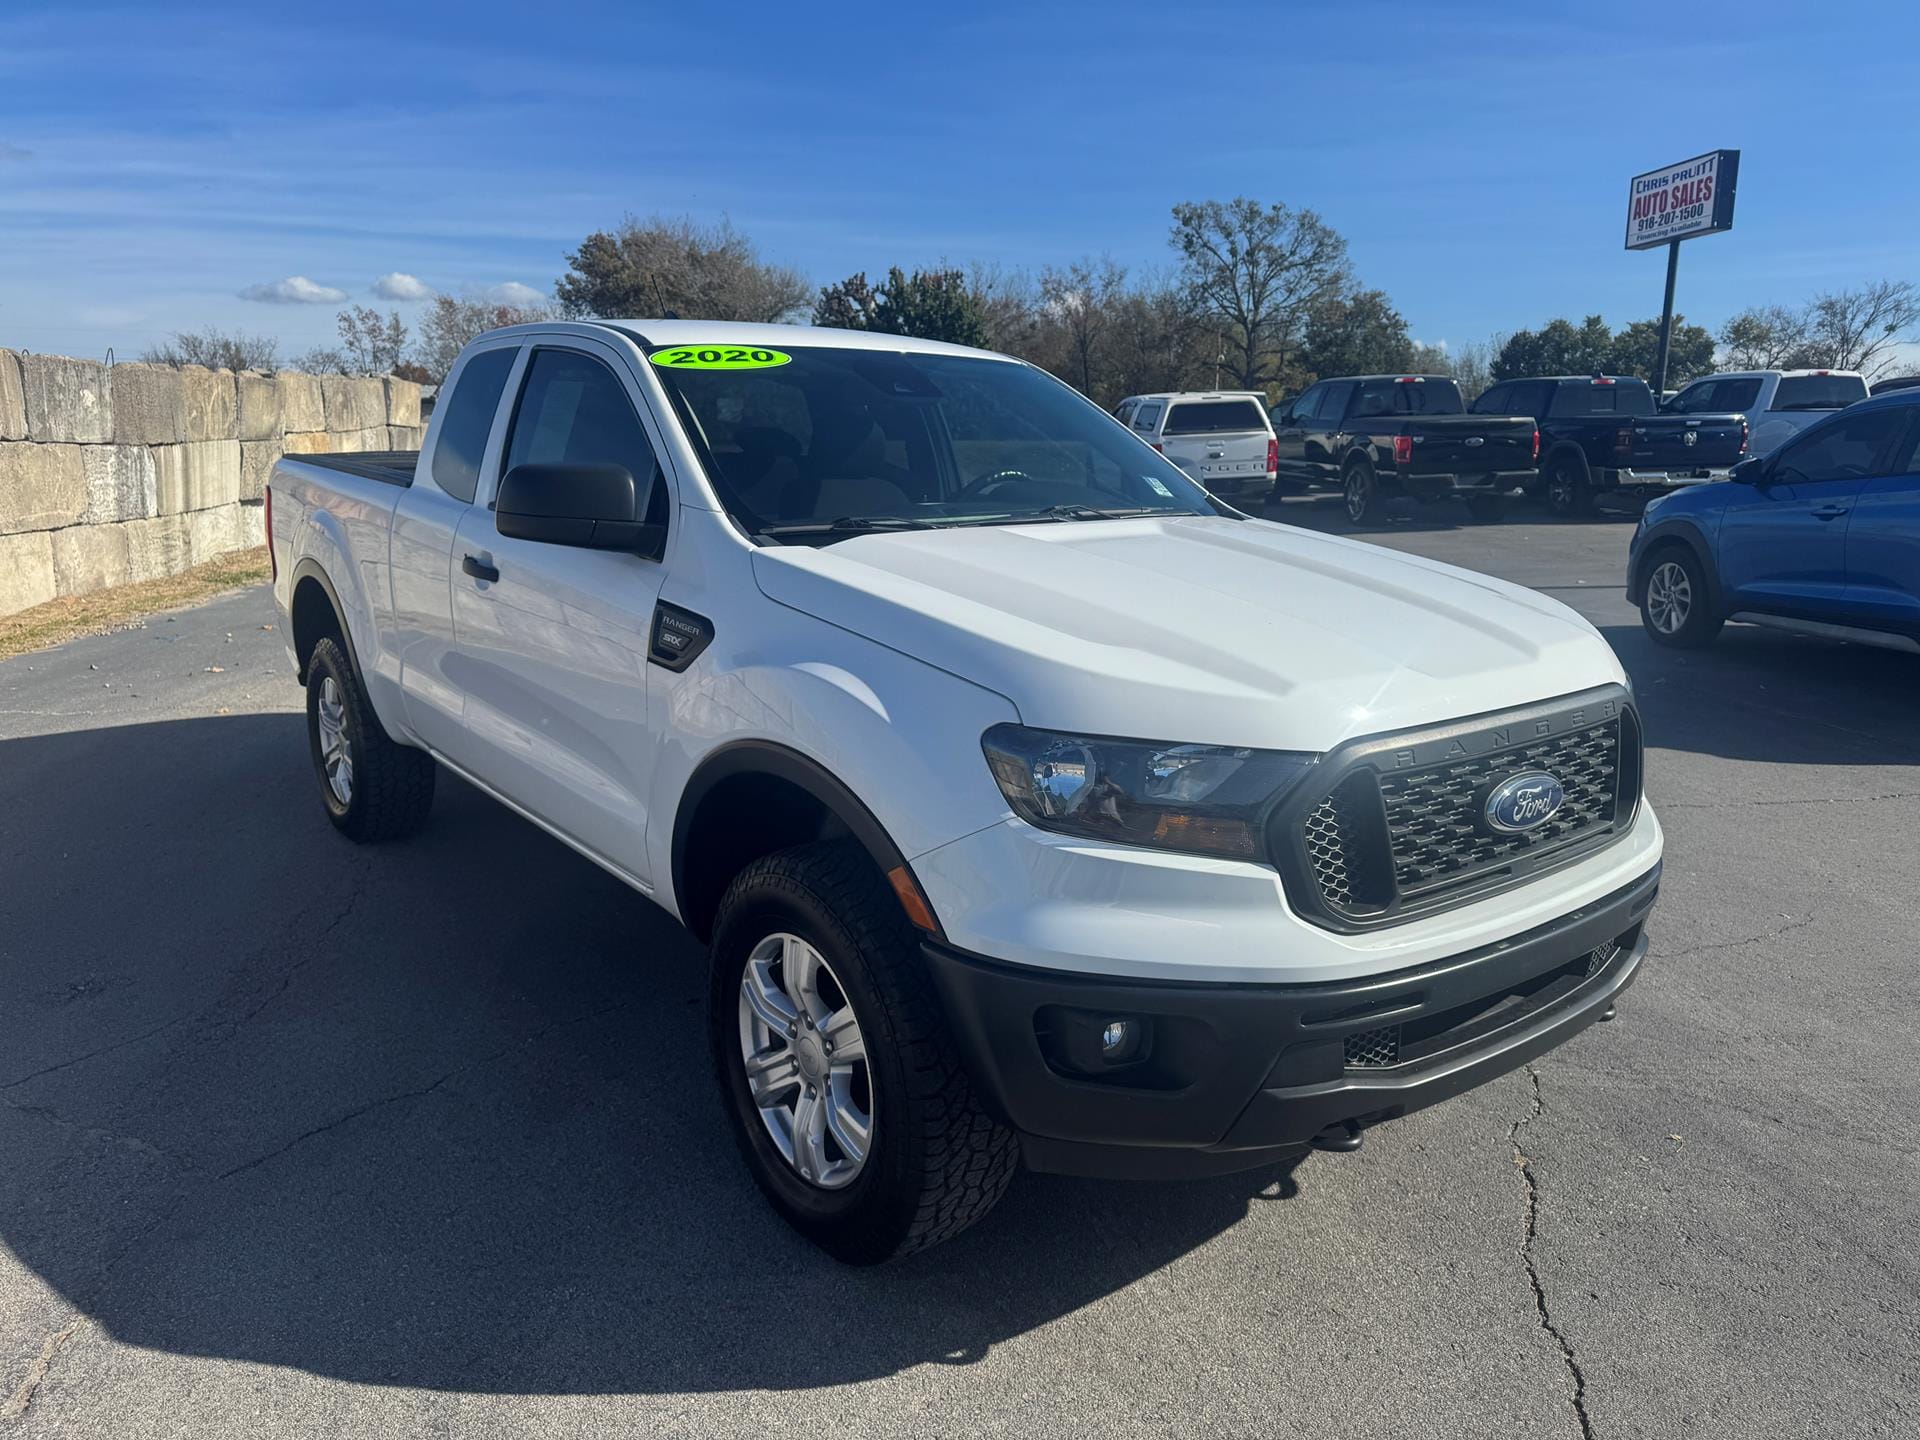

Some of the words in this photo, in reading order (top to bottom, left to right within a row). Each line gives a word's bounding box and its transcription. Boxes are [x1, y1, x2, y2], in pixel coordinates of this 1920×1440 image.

[1636, 175, 1669, 194] CHRIS
[1672, 156, 1716, 183] PRUITT
[1633, 189, 1669, 220] AUTO
[1671, 175, 1714, 210] SALES
[1636, 226, 1669, 241] Financing
[1669, 220, 1702, 234] Available
[1638, 203, 1705, 232] 918-207-1500
[669, 350, 776, 364] 2020
[1200, 464, 1264, 473] NGER
[662, 616, 700, 636] RANGER
[1395, 700, 1617, 768] RANGER
[1513, 785, 1553, 822] Ford
